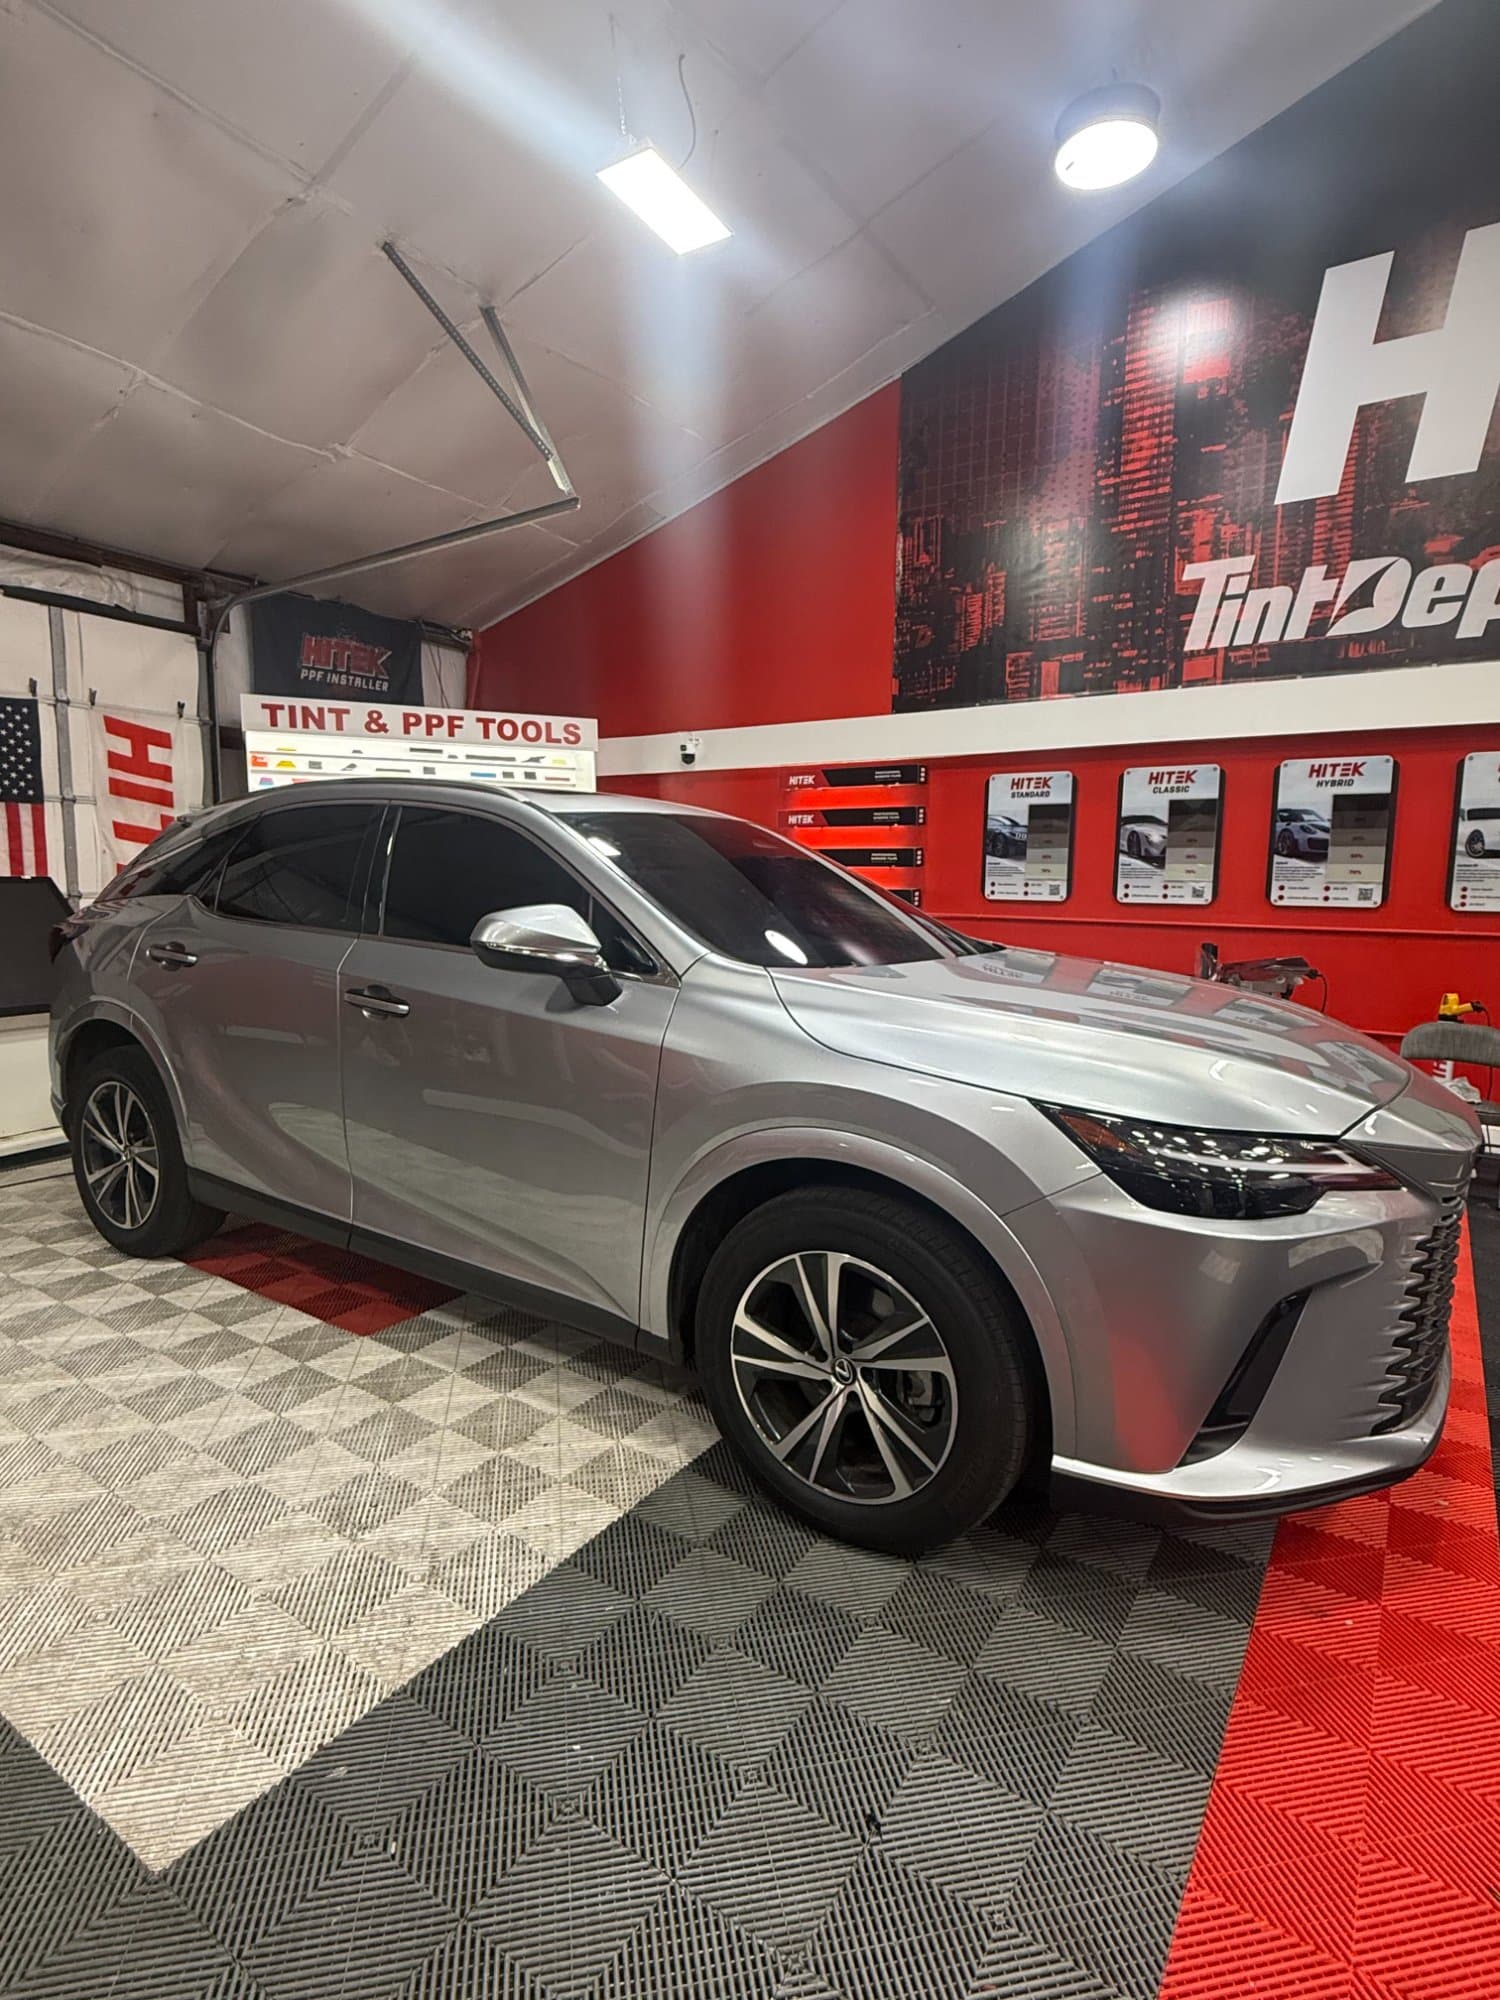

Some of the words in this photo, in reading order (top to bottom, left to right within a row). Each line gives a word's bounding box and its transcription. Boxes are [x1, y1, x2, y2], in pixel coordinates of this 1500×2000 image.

[301, 635, 393, 680] HITEK
[301, 668, 325, 681] PPF
[326, 672, 390, 692] INSTALLER
[261, 702, 351, 732] TINT
[364, 709, 390, 734] &
[402, 712, 465, 738] PPF
[475, 716, 582, 745] TOOLS
[1148, 769, 1199, 785] HITEK
[1308, 761, 1368, 778] HITEK
[788, 774, 816, 786] HITEK
[1010, 775, 1054, 790] HITEK
[1316, 778, 1355, 788] HYBRID
[1010, 790, 1051, 799] STANDARD
[1152, 785, 1191, 794] CLASSIC
[787, 813, 815, 825] HITEK
